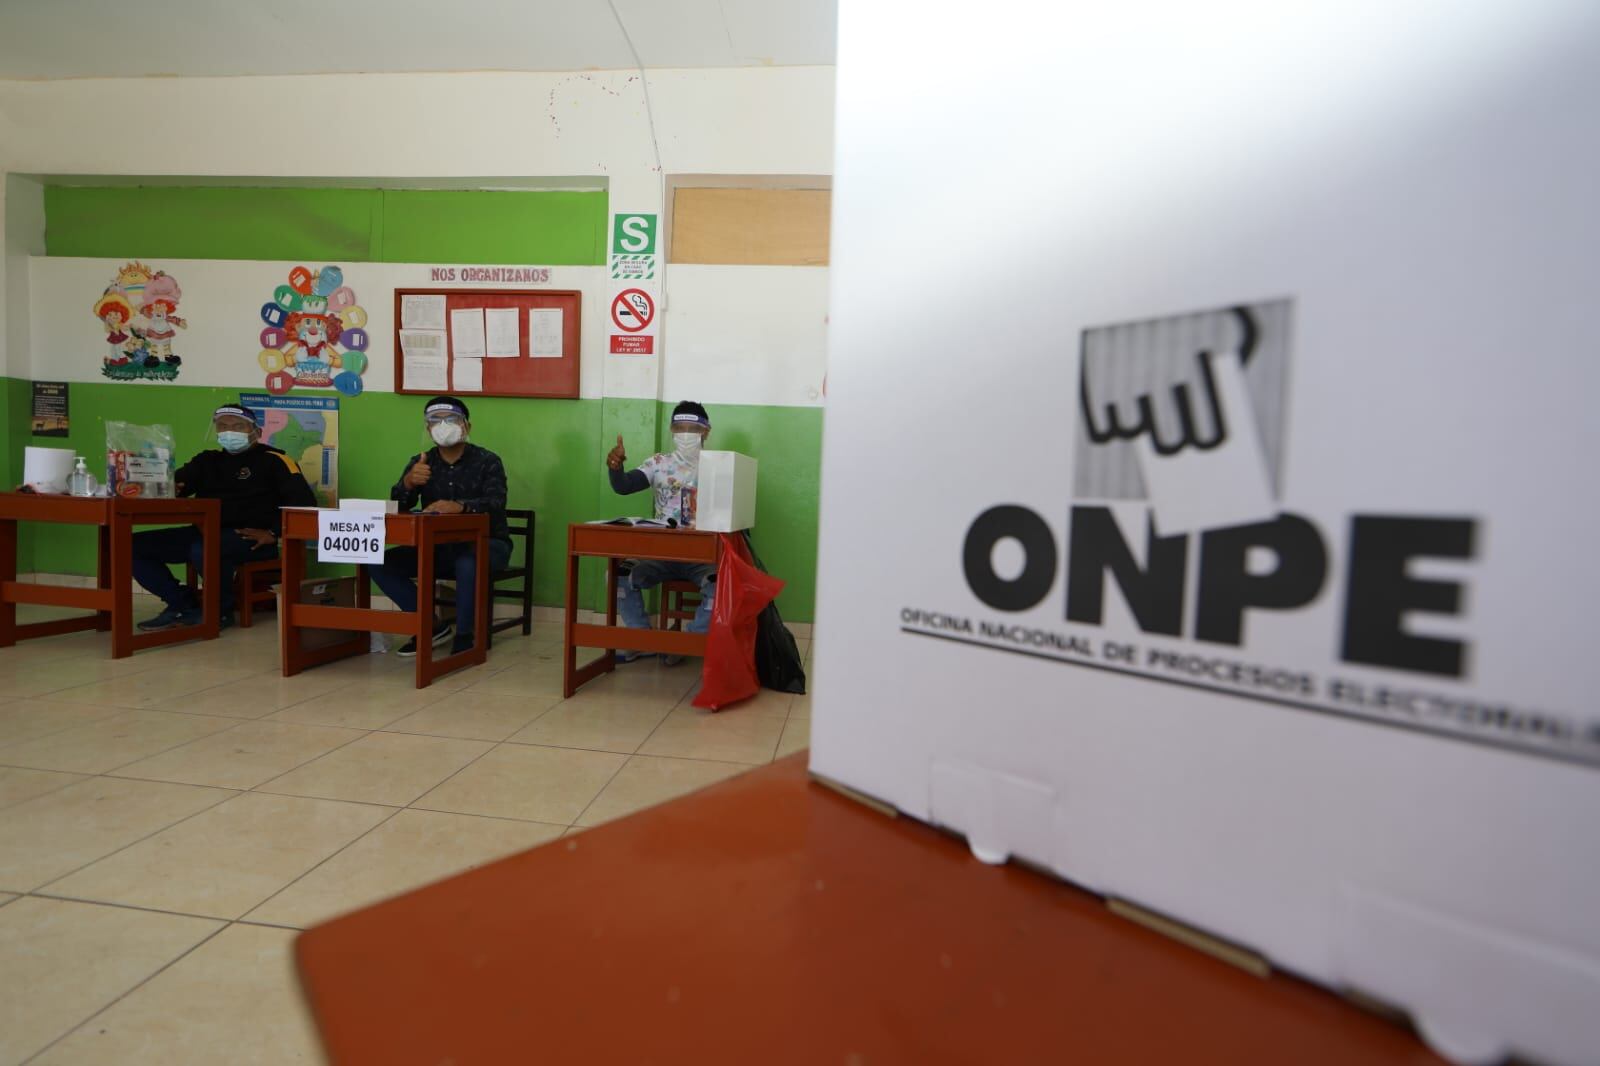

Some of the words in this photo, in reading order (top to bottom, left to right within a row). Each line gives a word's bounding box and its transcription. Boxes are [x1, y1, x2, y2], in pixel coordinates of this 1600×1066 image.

[620, 216, 649, 252] S
[431, 267, 456, 282] NOS
[461, 268, 549, 283] ORGANIZAMOS
[329, 522, 360, 533] MESA
[323, 536, 379, 553] 040016
[963, 503, 1476, 680] ONPE
[901, 607, 974, 635] OFICINA
[978, 620, 1092, 658] NACIONAL
[1102, 640, 1138, 664] DE
[1147, 647, 1315, 696] PROCESOS
